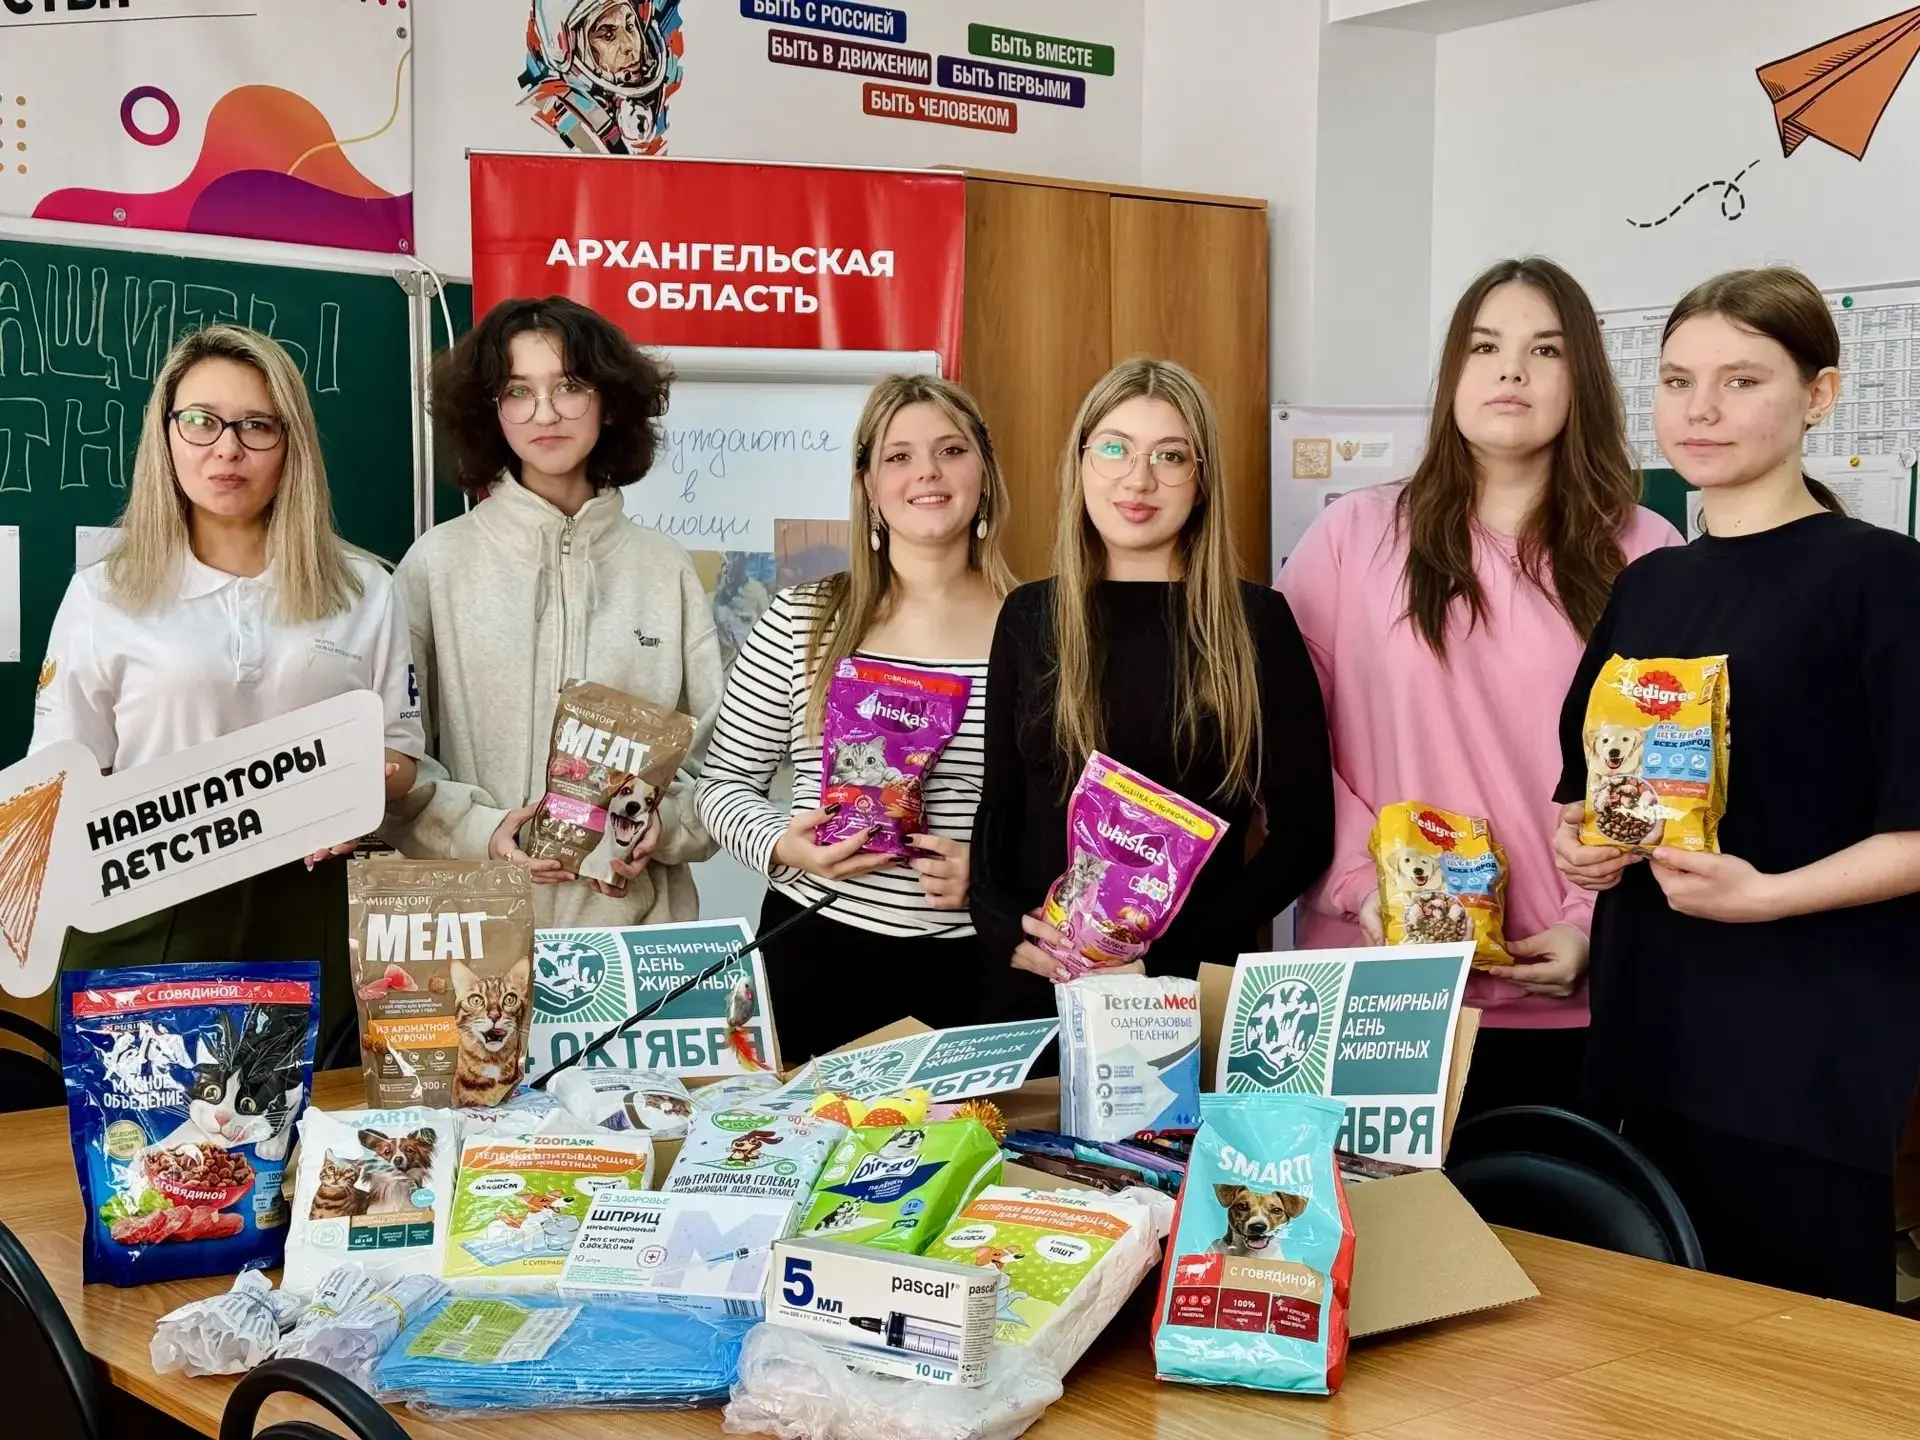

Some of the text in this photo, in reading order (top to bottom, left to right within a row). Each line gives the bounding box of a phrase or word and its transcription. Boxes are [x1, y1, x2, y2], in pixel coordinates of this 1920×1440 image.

[806, 2, 816, 20] С
[821, 5, 895, 36] РОССИЕЙ
[771, 36, 929, 79] БЫТЬ В ДВИЖЕНИИ
[991, 33, 1093, 67] БЫТЬ ВМЕСТЕ
[952, 64, 1072, 101] БЫТЬ ПЕРВЫМИ
[870, 90, 1010, 128] БЫТЬ ЧЕЛОВЕКОМ
[546, 237, 895, 278] АРХАНГЕЛЬСКАЯ
[627, 279, 819, 315] ОБЛАСТЬ
[680, 470, 699, 504] в
[556, 716, 651, 776] MEAT
[86, 738, 327, 851] НАВИГАТОРЫ
[1408, 810, 1468, 839] Pedigree
[100, 808, 263, 898] ДЕТСТВА
[1096, 820, 1167, 867] whiskas
[365, 911, 487, 963] MEAT
[633, 939, 743, 956] ВСЕМИРНЫЙ
[636, 957, 685, 972] ДЕНЬ
[157, 984, 240, 1001] ГОВЯДИНОЙ
[638, 973, 741, 992] ЖИВОНЫХ
[1103, 993, 1198, 1011] TerezaMed
[1347, 988, 1449, 1014] ВСЕМИРНЫЙ
[376, 1020, 450, 1034] ИЗ АРОМАТНОЙ
[1111, 1016, 1193, 1029] ОДНОРАЗОВЫЕ
[1342, 1018, 1386, 1039] ДЕНЬ
[390, 1033, 436, 1043] КУРОЧКИ
[936, 1027, 1048, 1051] ВСЕМИРНЫЙ
[921, 1043, 1026, 1071] ЖИВОТНЫХ
[928, 1045, 976, 1061] ДЕНЬ
[1337, 1039, 1432, 1061] ЖИВОТНЫХ
[422, 1081, 440, 1090] 300
[103, 1090, 185, 1110] ОБЪЕДЕНИЕ
[162, 1180, 227, 1201] ГОВЯДИНОЙ
[673, 1172, 800, 1189] УЛЬТРАТОНКАЯ ГЕЛЕВАЯ
[614, 1194, 670, 1205] ЗДОРОВЬЕ
[590, 1209, 662, 1226] ШПРИЦ
[582, 1233, 589, 1242] 3
[586, 1224, 657, 1233] инъекционный
[783, 1256, 843, 1314] 5 мл
[1230, 1265, 1317, 1290] С ГОВЯДИНОЙ
[1233, 1299, 1256, 1309] 100%
[915, 1362, 953, 1382] 10 шт
